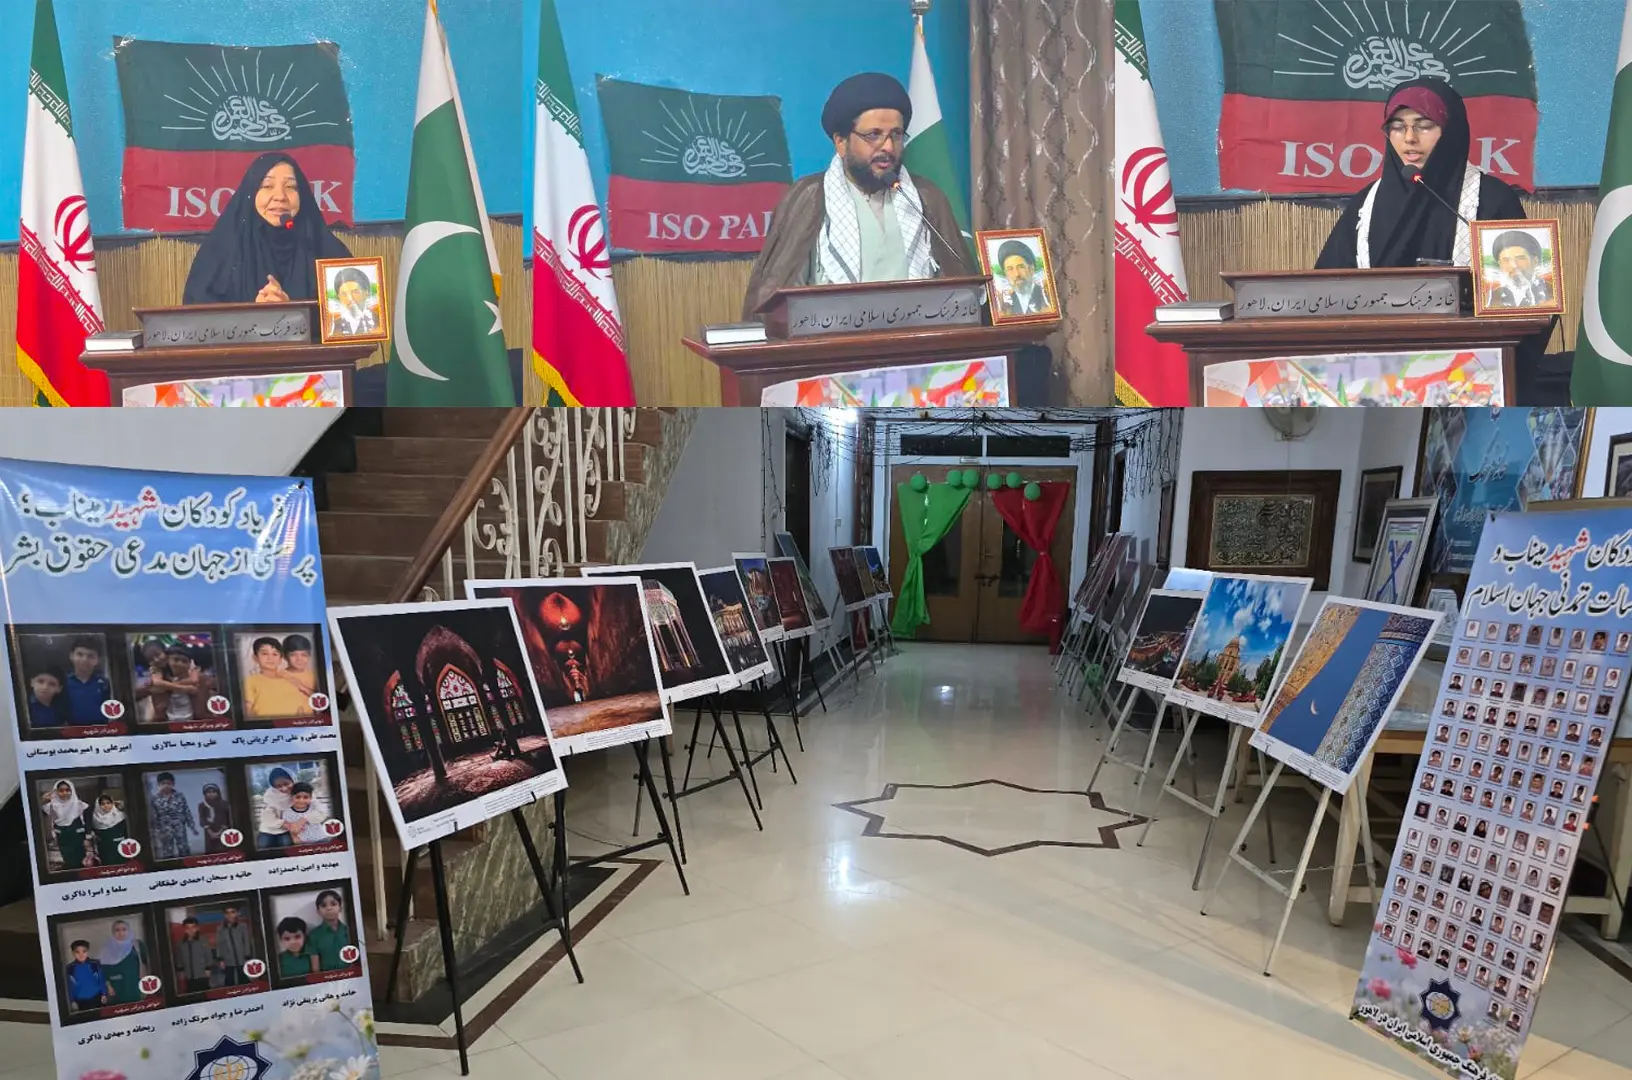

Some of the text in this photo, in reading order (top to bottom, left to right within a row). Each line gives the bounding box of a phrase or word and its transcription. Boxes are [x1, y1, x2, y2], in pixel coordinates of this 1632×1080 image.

[1277, 140, 1384, 179] ISO
[647, 212, 711, 240] ISO
[924, 291, 960, 321] فرهنگ
[1308, 295, 1344, 313] اسلامی
[1346, 292, 1388, 311] جمهوری
[1391, 282, 1432, 311] فرهنگ
[1435, 292, 1455, 306] خانه
[259, 314, 291, 338] فرهنگ
[854, 309, 885, 328] اسلامی
[887, 304, 922, 324] جمهوری
[199, 326, 226, 342] اسلامی
[226, 323, 258, 340] جمهوری
[105, 489, 158, 528] شهید
[162, 491, 243, 528] کودکان
[3, 535, 39, 574] بشر
[46, 535, 108, 573] حقوق
[115, 539, 167, 574] مدعی
[172, 546, 227, 581] جهان
[230, 549, 248, 572] از
[1503, 538, 1546, 572] میناب
[1548, 530, 1588, 570] شهید
[1466, 583, 1510, 613] اسلام
[1509, 584, 1549, 618] جهان
[1387, 1019, 1406, 1036] ایران
[1405, 1030, 1430, 1047] اسلامی
[1429, 1044, 1460, 1067] جمهوری
